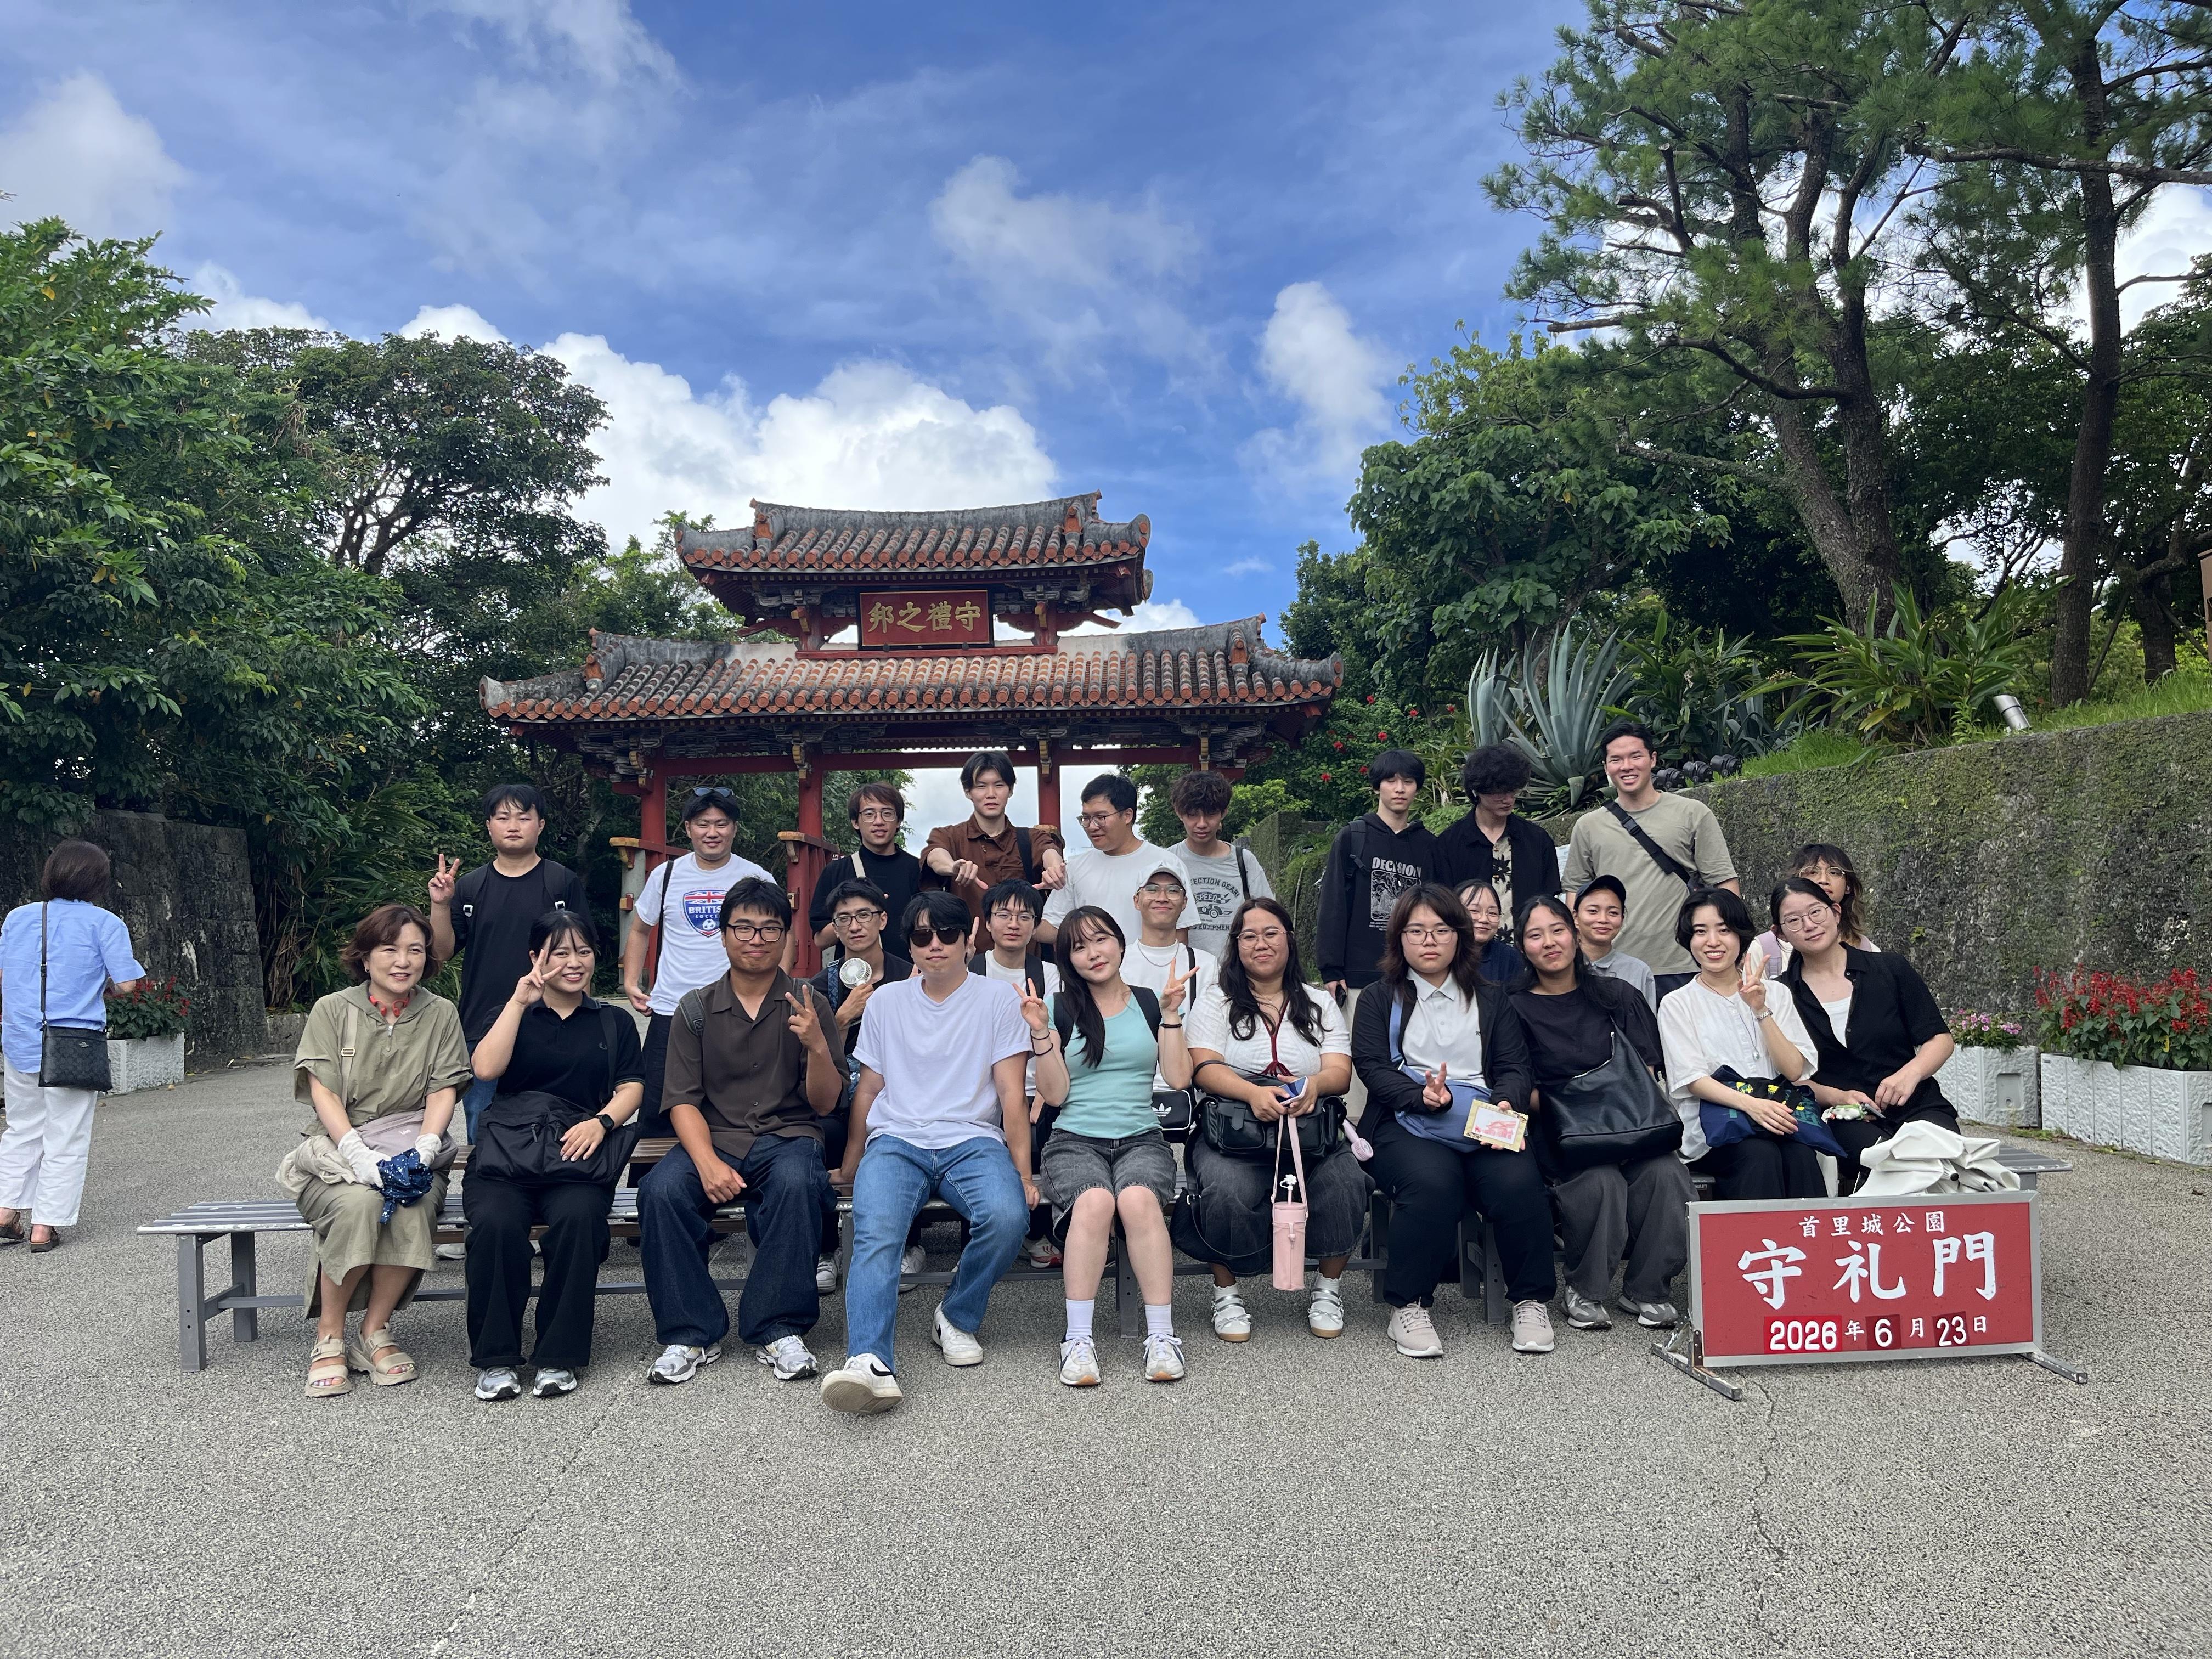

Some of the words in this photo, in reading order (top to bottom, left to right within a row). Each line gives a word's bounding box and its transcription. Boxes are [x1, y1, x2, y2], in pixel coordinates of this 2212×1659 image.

[1372, 857, 1421, 878] DECISION
[1190, 877, 1221, 885] ECTION
[688, 906, 722, 914] BRITIS
[1798, 1210, 1945, 1238] 首里城公園
[1736, 1231, 1997, 1310] 守礼門
